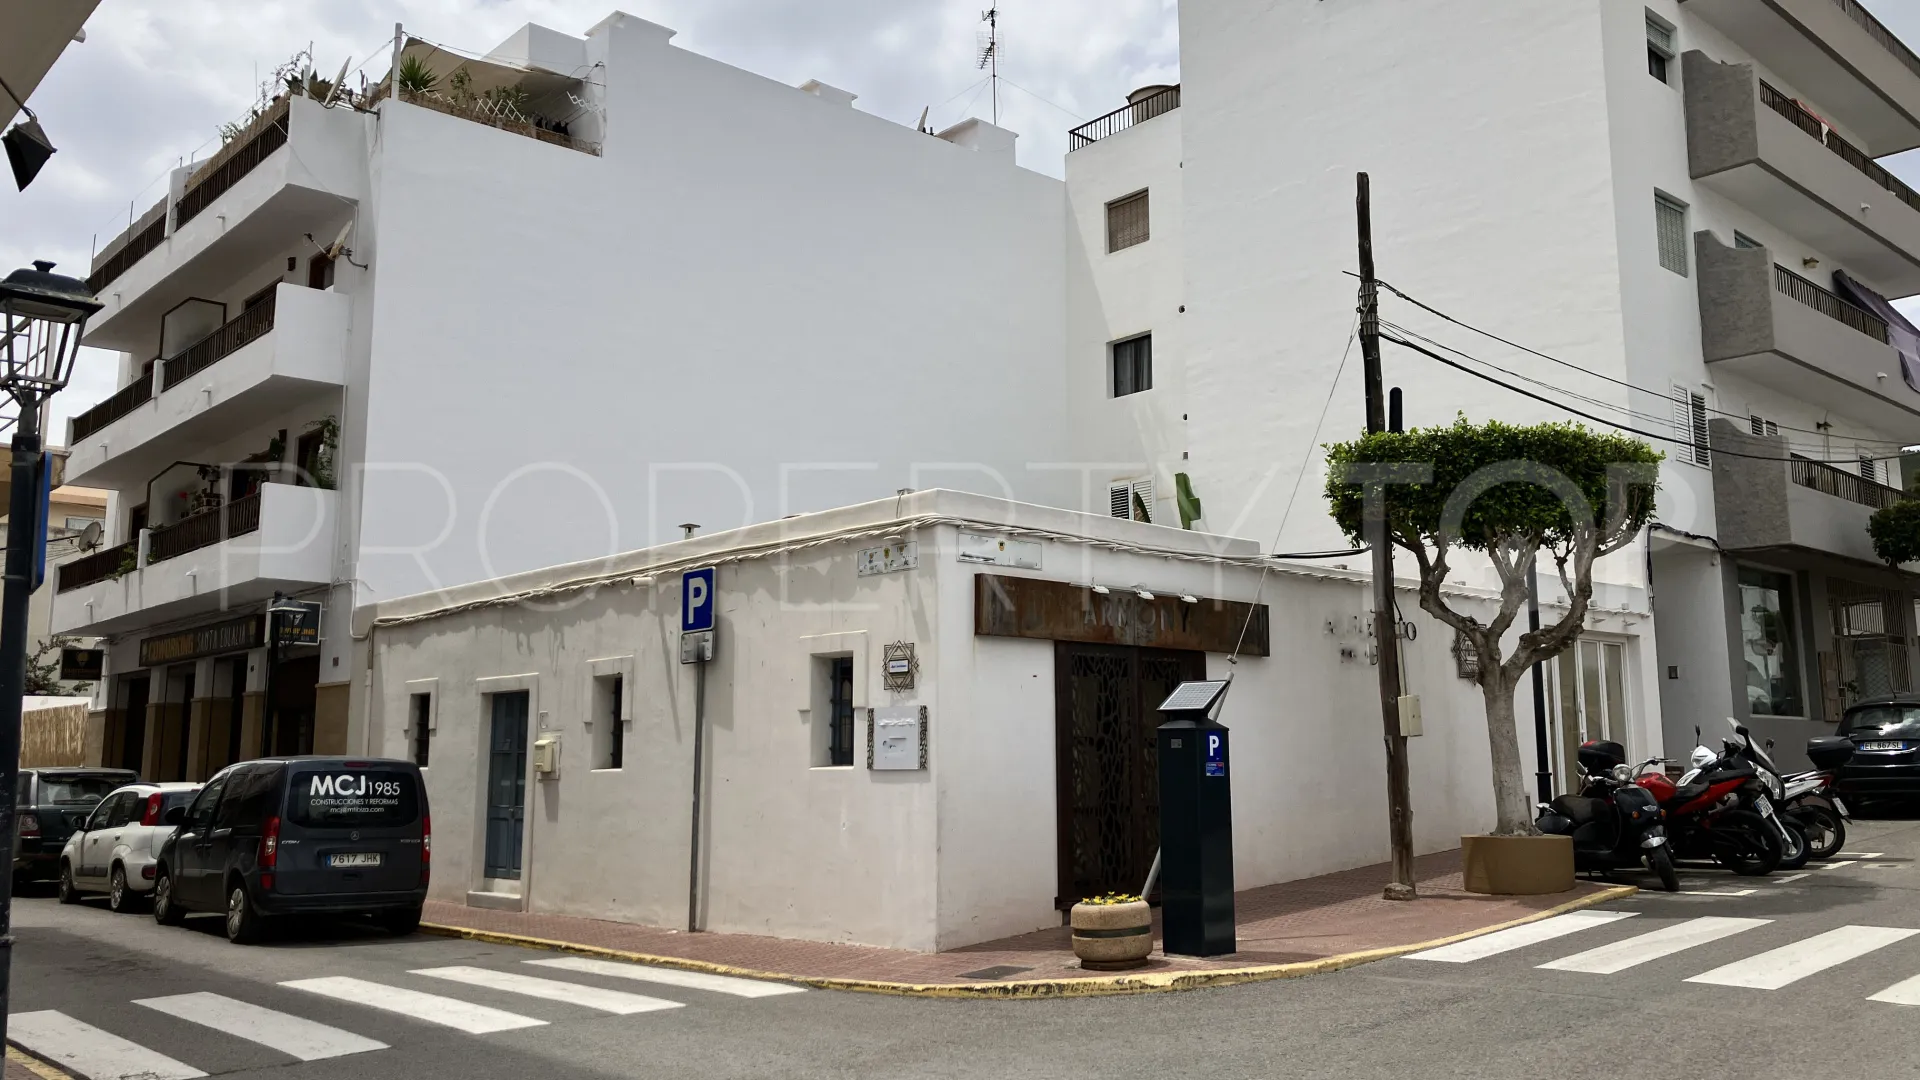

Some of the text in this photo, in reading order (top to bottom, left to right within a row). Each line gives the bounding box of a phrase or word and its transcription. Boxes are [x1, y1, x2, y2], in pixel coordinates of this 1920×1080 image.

[688, 576, 708, 625] P
[1209, 735, 1220, 757] P
[333, 853, 378, 864] 7617 JHK
